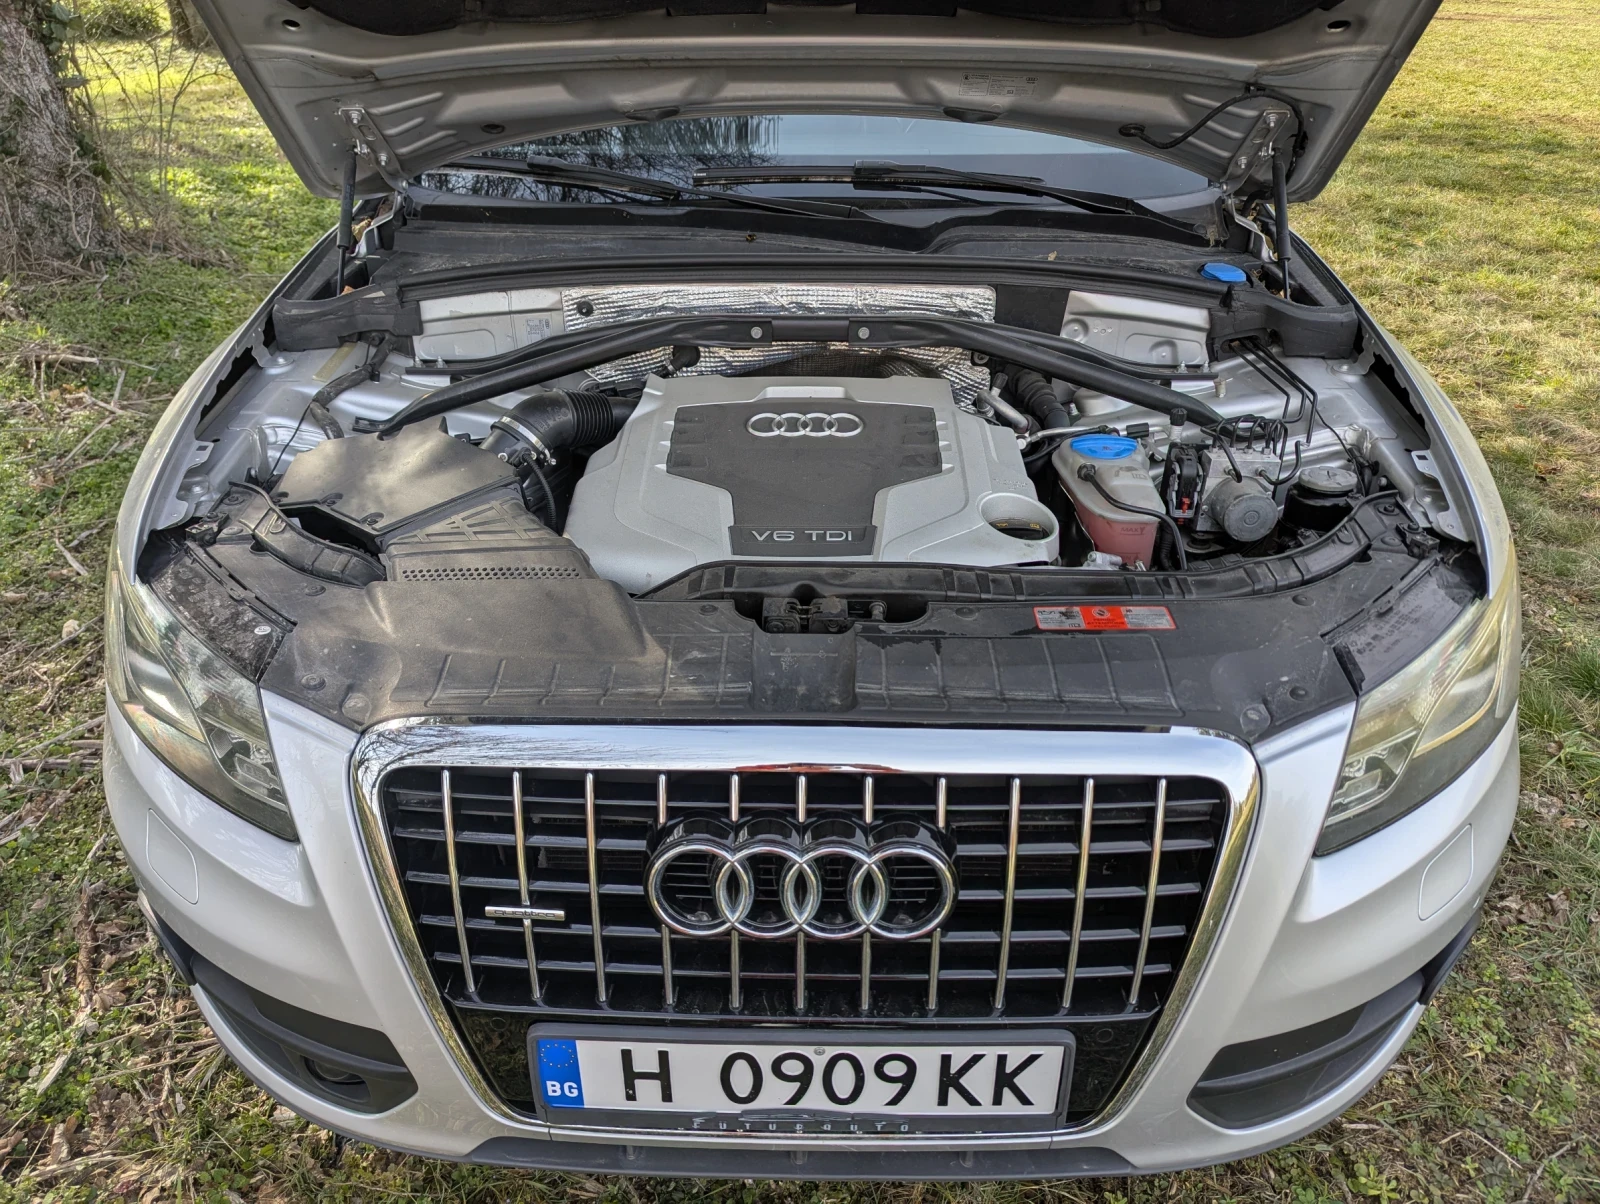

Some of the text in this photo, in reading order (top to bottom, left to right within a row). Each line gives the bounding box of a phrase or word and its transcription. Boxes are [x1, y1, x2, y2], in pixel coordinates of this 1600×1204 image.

[751, 530, 852, 541] V6 TDI
[494, 909, 556, 918] quattro
[620, 1048, 1044, 1107] H 0909 KK
[546, 1080, 579, 1098] BG
